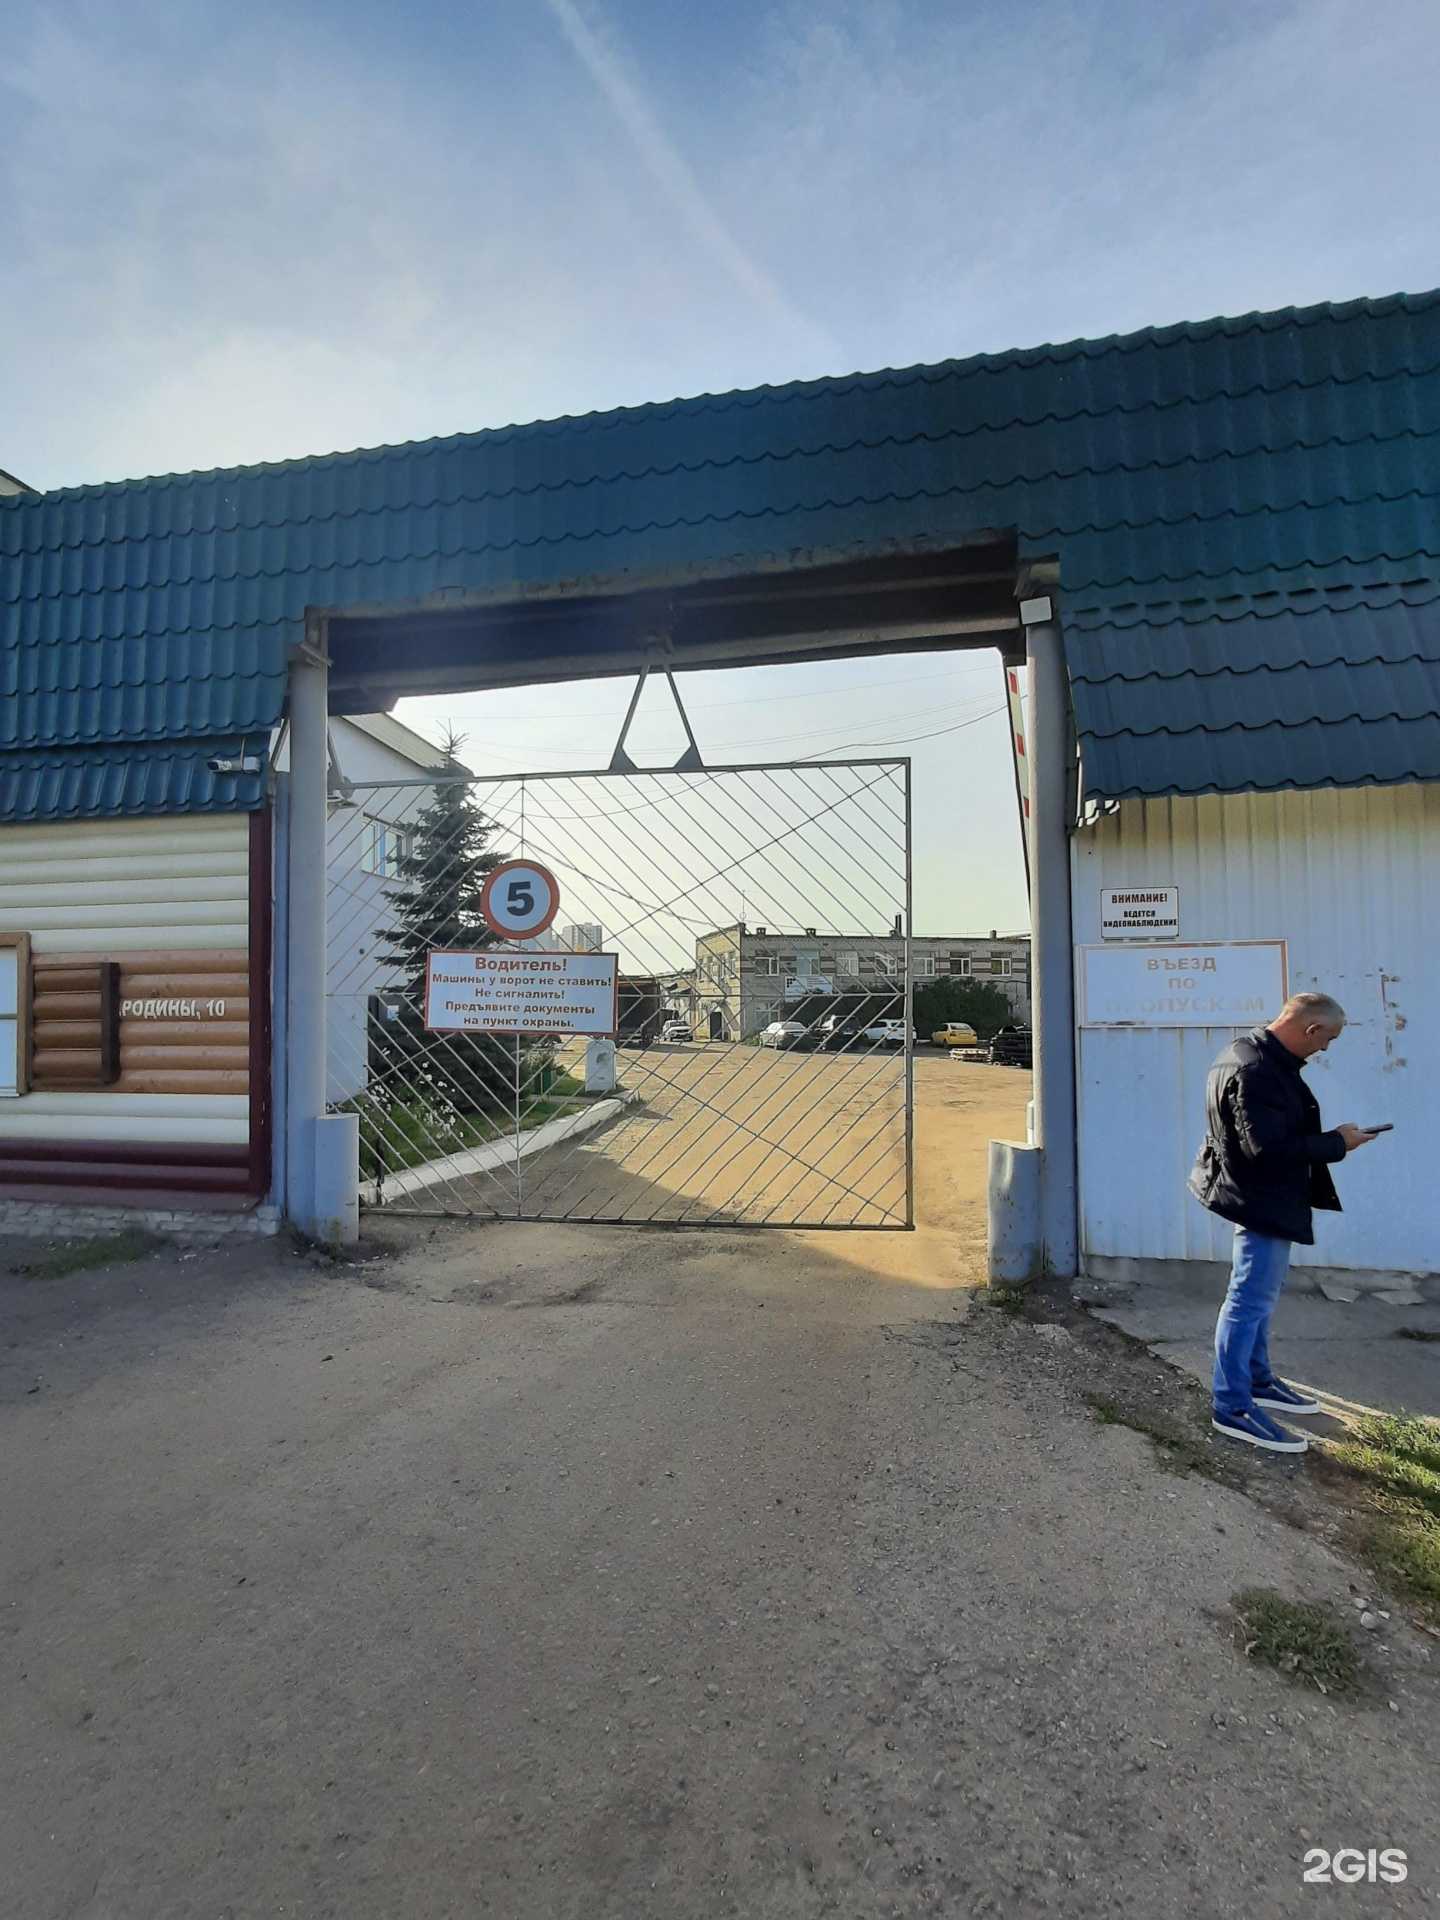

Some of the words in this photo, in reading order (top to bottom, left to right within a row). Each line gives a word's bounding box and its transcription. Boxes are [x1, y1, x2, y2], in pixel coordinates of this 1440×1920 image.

[507, 881, 535, 916] 5
[1112, 893, 1168, 904] ВНИМАНИЕ!
[1123, 910, 1156, 918] ВЕДЕТСЯ
[1103, 919, 1177, 928] ВИДЕОНАБЛЮДЕНИЕ
[475, 957, 567, 972] Водитель!
[1147, 957, 1217, 972] ВЪЕЗД
[432, 973, 485, 984] Машины
[489, 976, 496, 986] у
[500, 977, 534, 986] ворот
[540, 978, 554, 986] не
[558, 977, 612, 987] ставить!
[1168, 977, 1197, 990] ПО
[475, 988, 491, 998] Не
[495, 990, 565, 999] сигналить!
[206, 999, 225, 1016] 10
[445, 1001, 520, 1013] Предъявите
[523, 1006, 595, 1015] документы
[1105, 995, 1265, 1013] ОПУСКМ
[463, 1017, 479, 1025] на
[483, 1018, 518, 1027] пункт
[522, 1018, 574, 1029] охраны.
